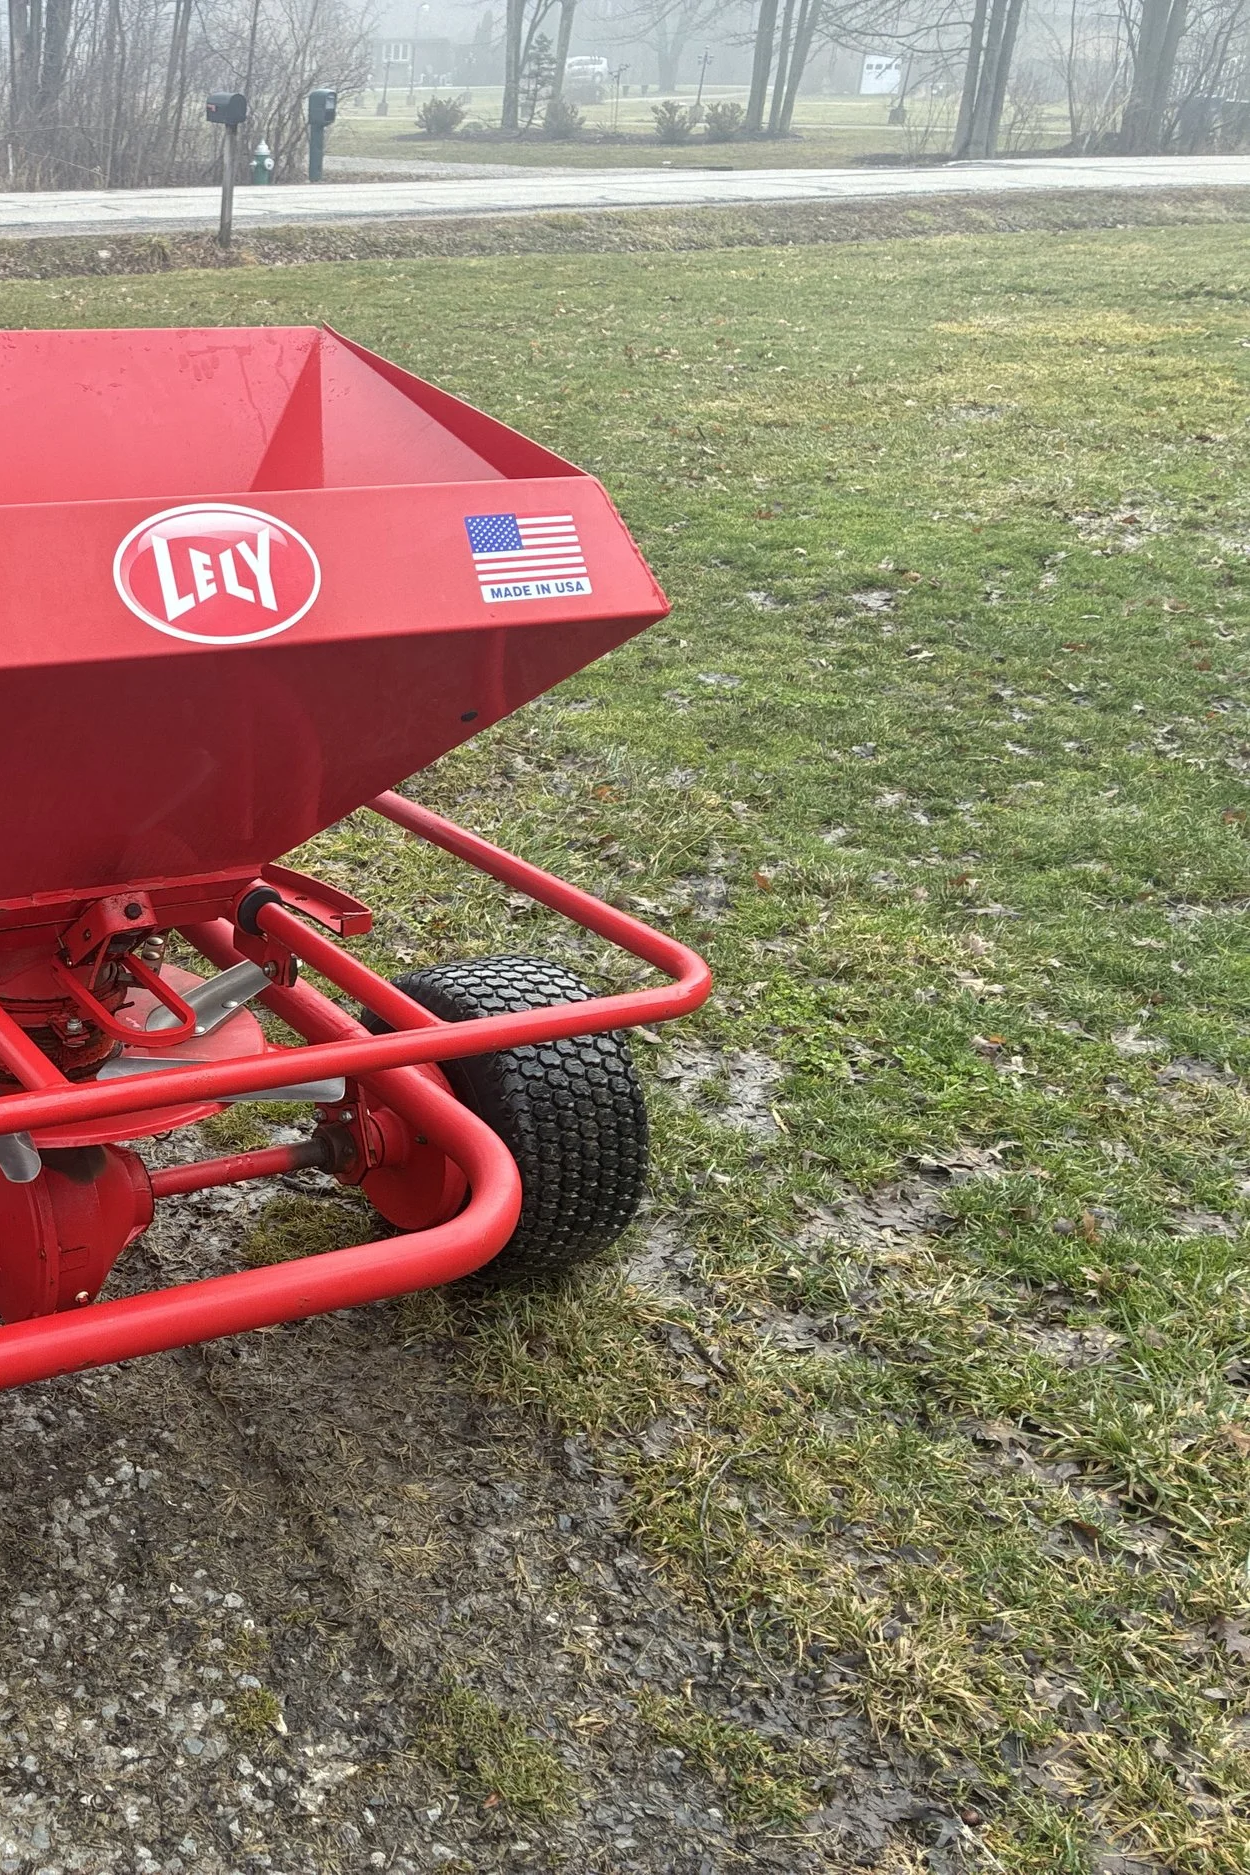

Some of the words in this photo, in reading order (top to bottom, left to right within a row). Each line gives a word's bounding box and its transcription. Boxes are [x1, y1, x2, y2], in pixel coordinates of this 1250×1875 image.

[151, 526, 279, 623] LELY
[490, 584, 532, 599] MADE
[535, 583, 552, 596] IN
[555, 580, 585, 594] USA
